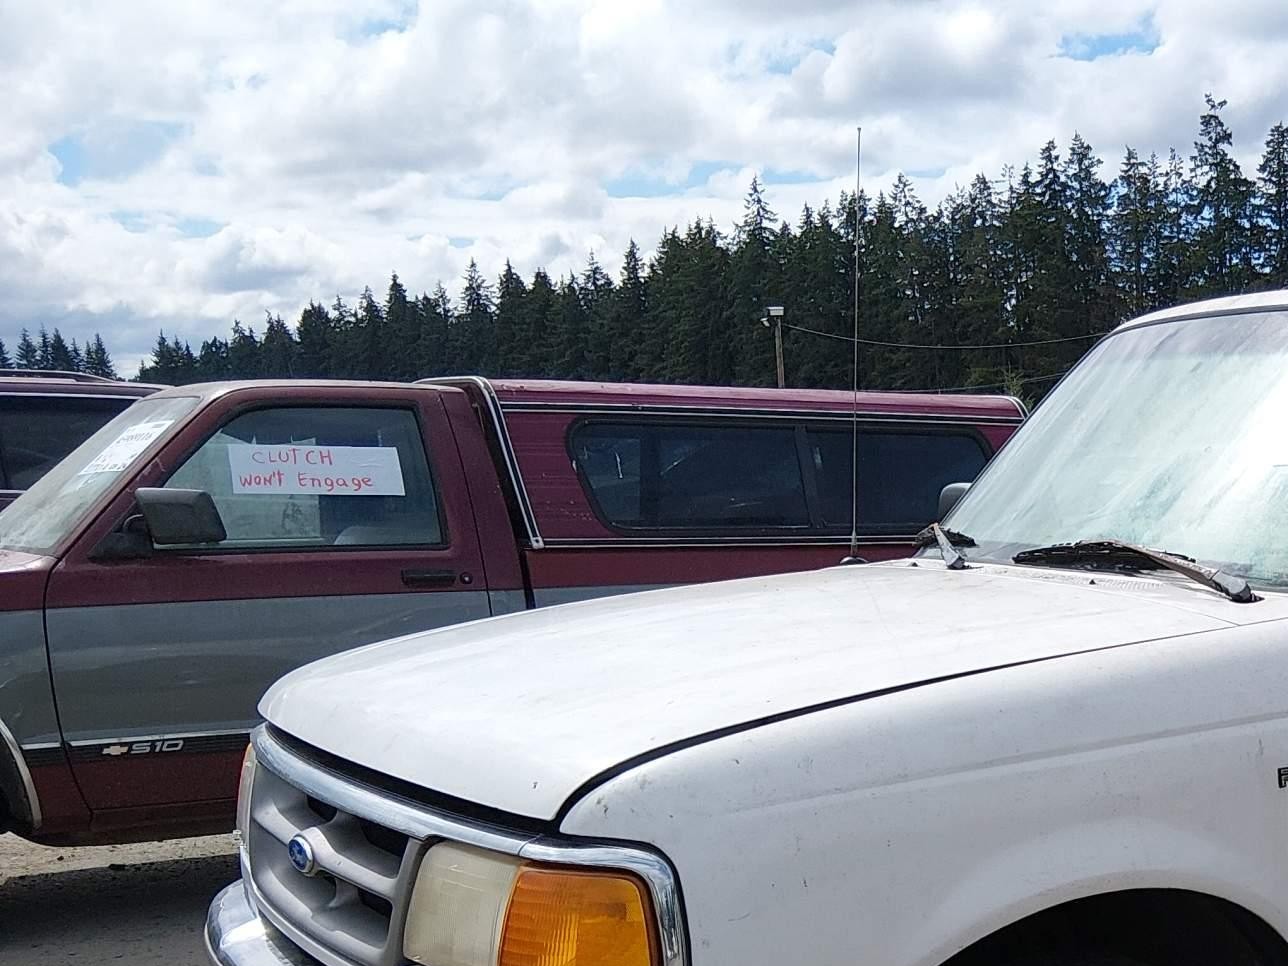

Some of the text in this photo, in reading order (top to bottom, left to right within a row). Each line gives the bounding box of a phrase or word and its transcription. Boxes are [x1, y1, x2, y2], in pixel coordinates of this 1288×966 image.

[251, 448, 333, 466] CLUTCH
[297, 471, 373, 492] Engage
[130, 740, 184, 754] S10
